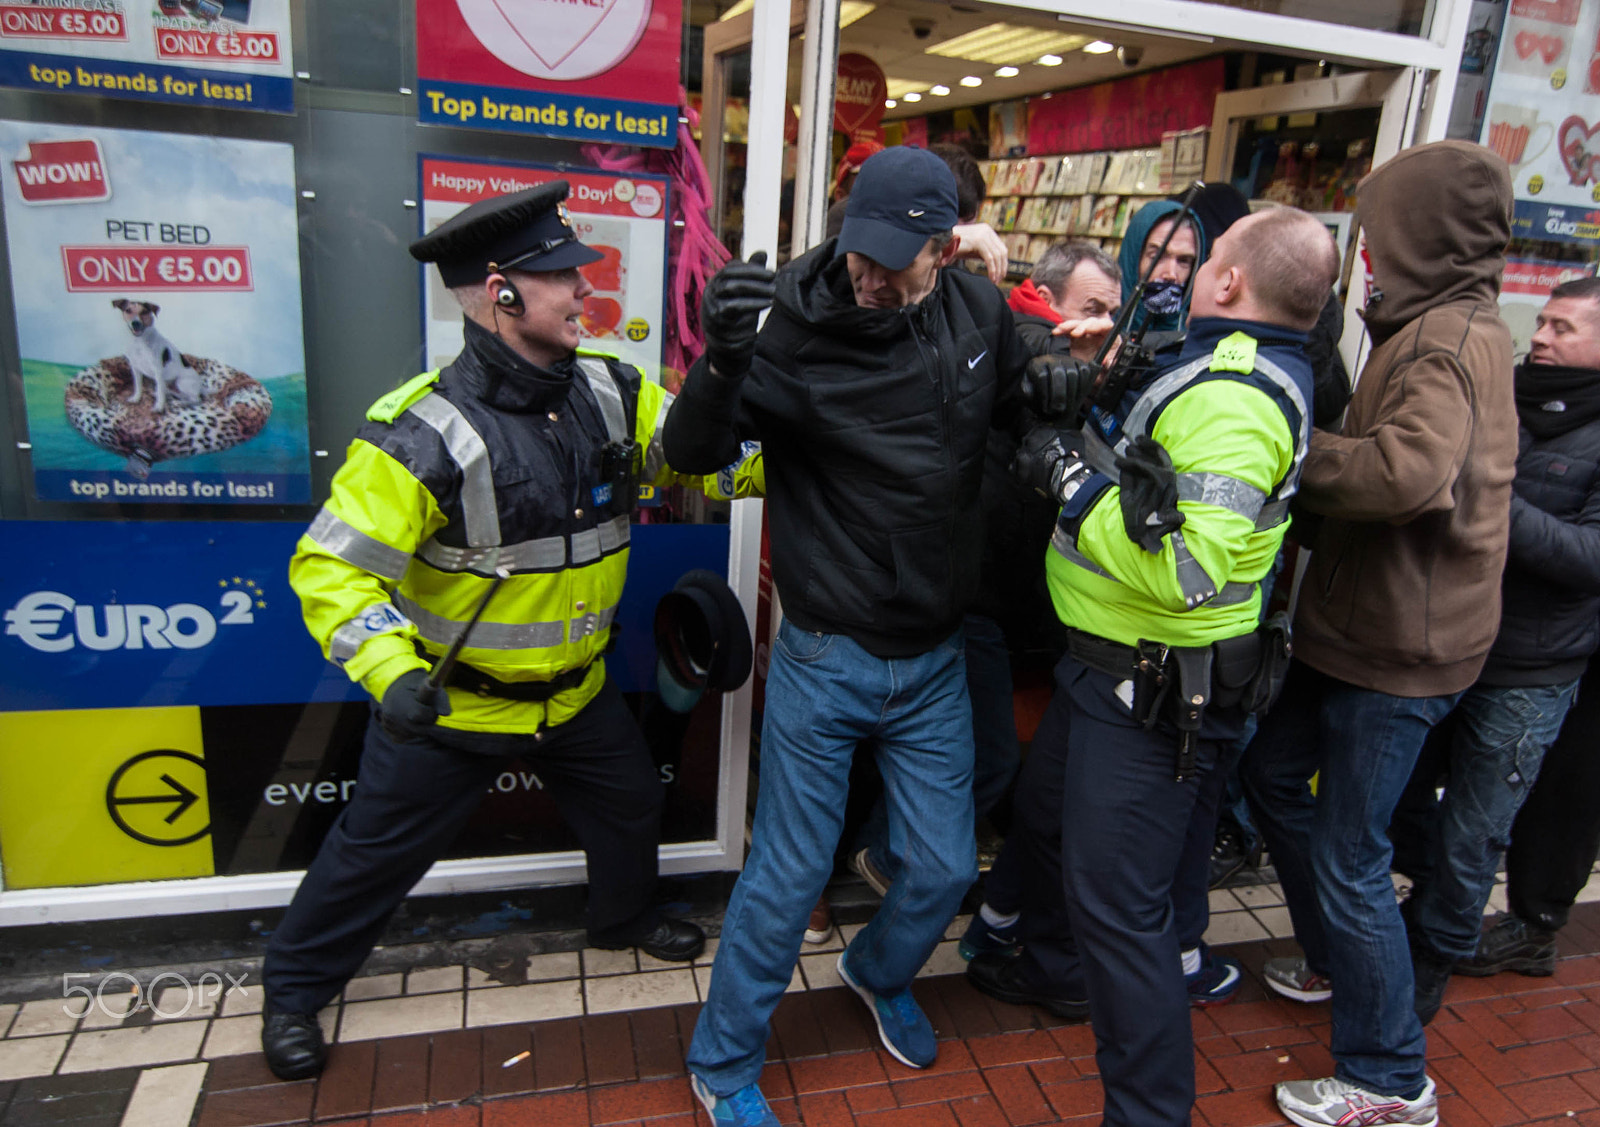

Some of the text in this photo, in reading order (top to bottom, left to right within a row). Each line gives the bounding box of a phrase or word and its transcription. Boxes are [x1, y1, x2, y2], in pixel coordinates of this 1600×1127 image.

[5, 11, 120, 35] ONLY €5.00
[162, 35, 274, 57] ONLY €5.00
[29, 64, 253, 102] top brands for less!
[427, 91, 668, 136] Top brands for less!
[20, 161, 103, 186] WOW!
[432, 172, 487, 195] Happy
[578, 186, 613, 205] Day!
[106, 220, 211, 246] PET BED
[79, 257, 242, 282] ONLY €5.00
[70, 479, 275, 498] top brands for less!
